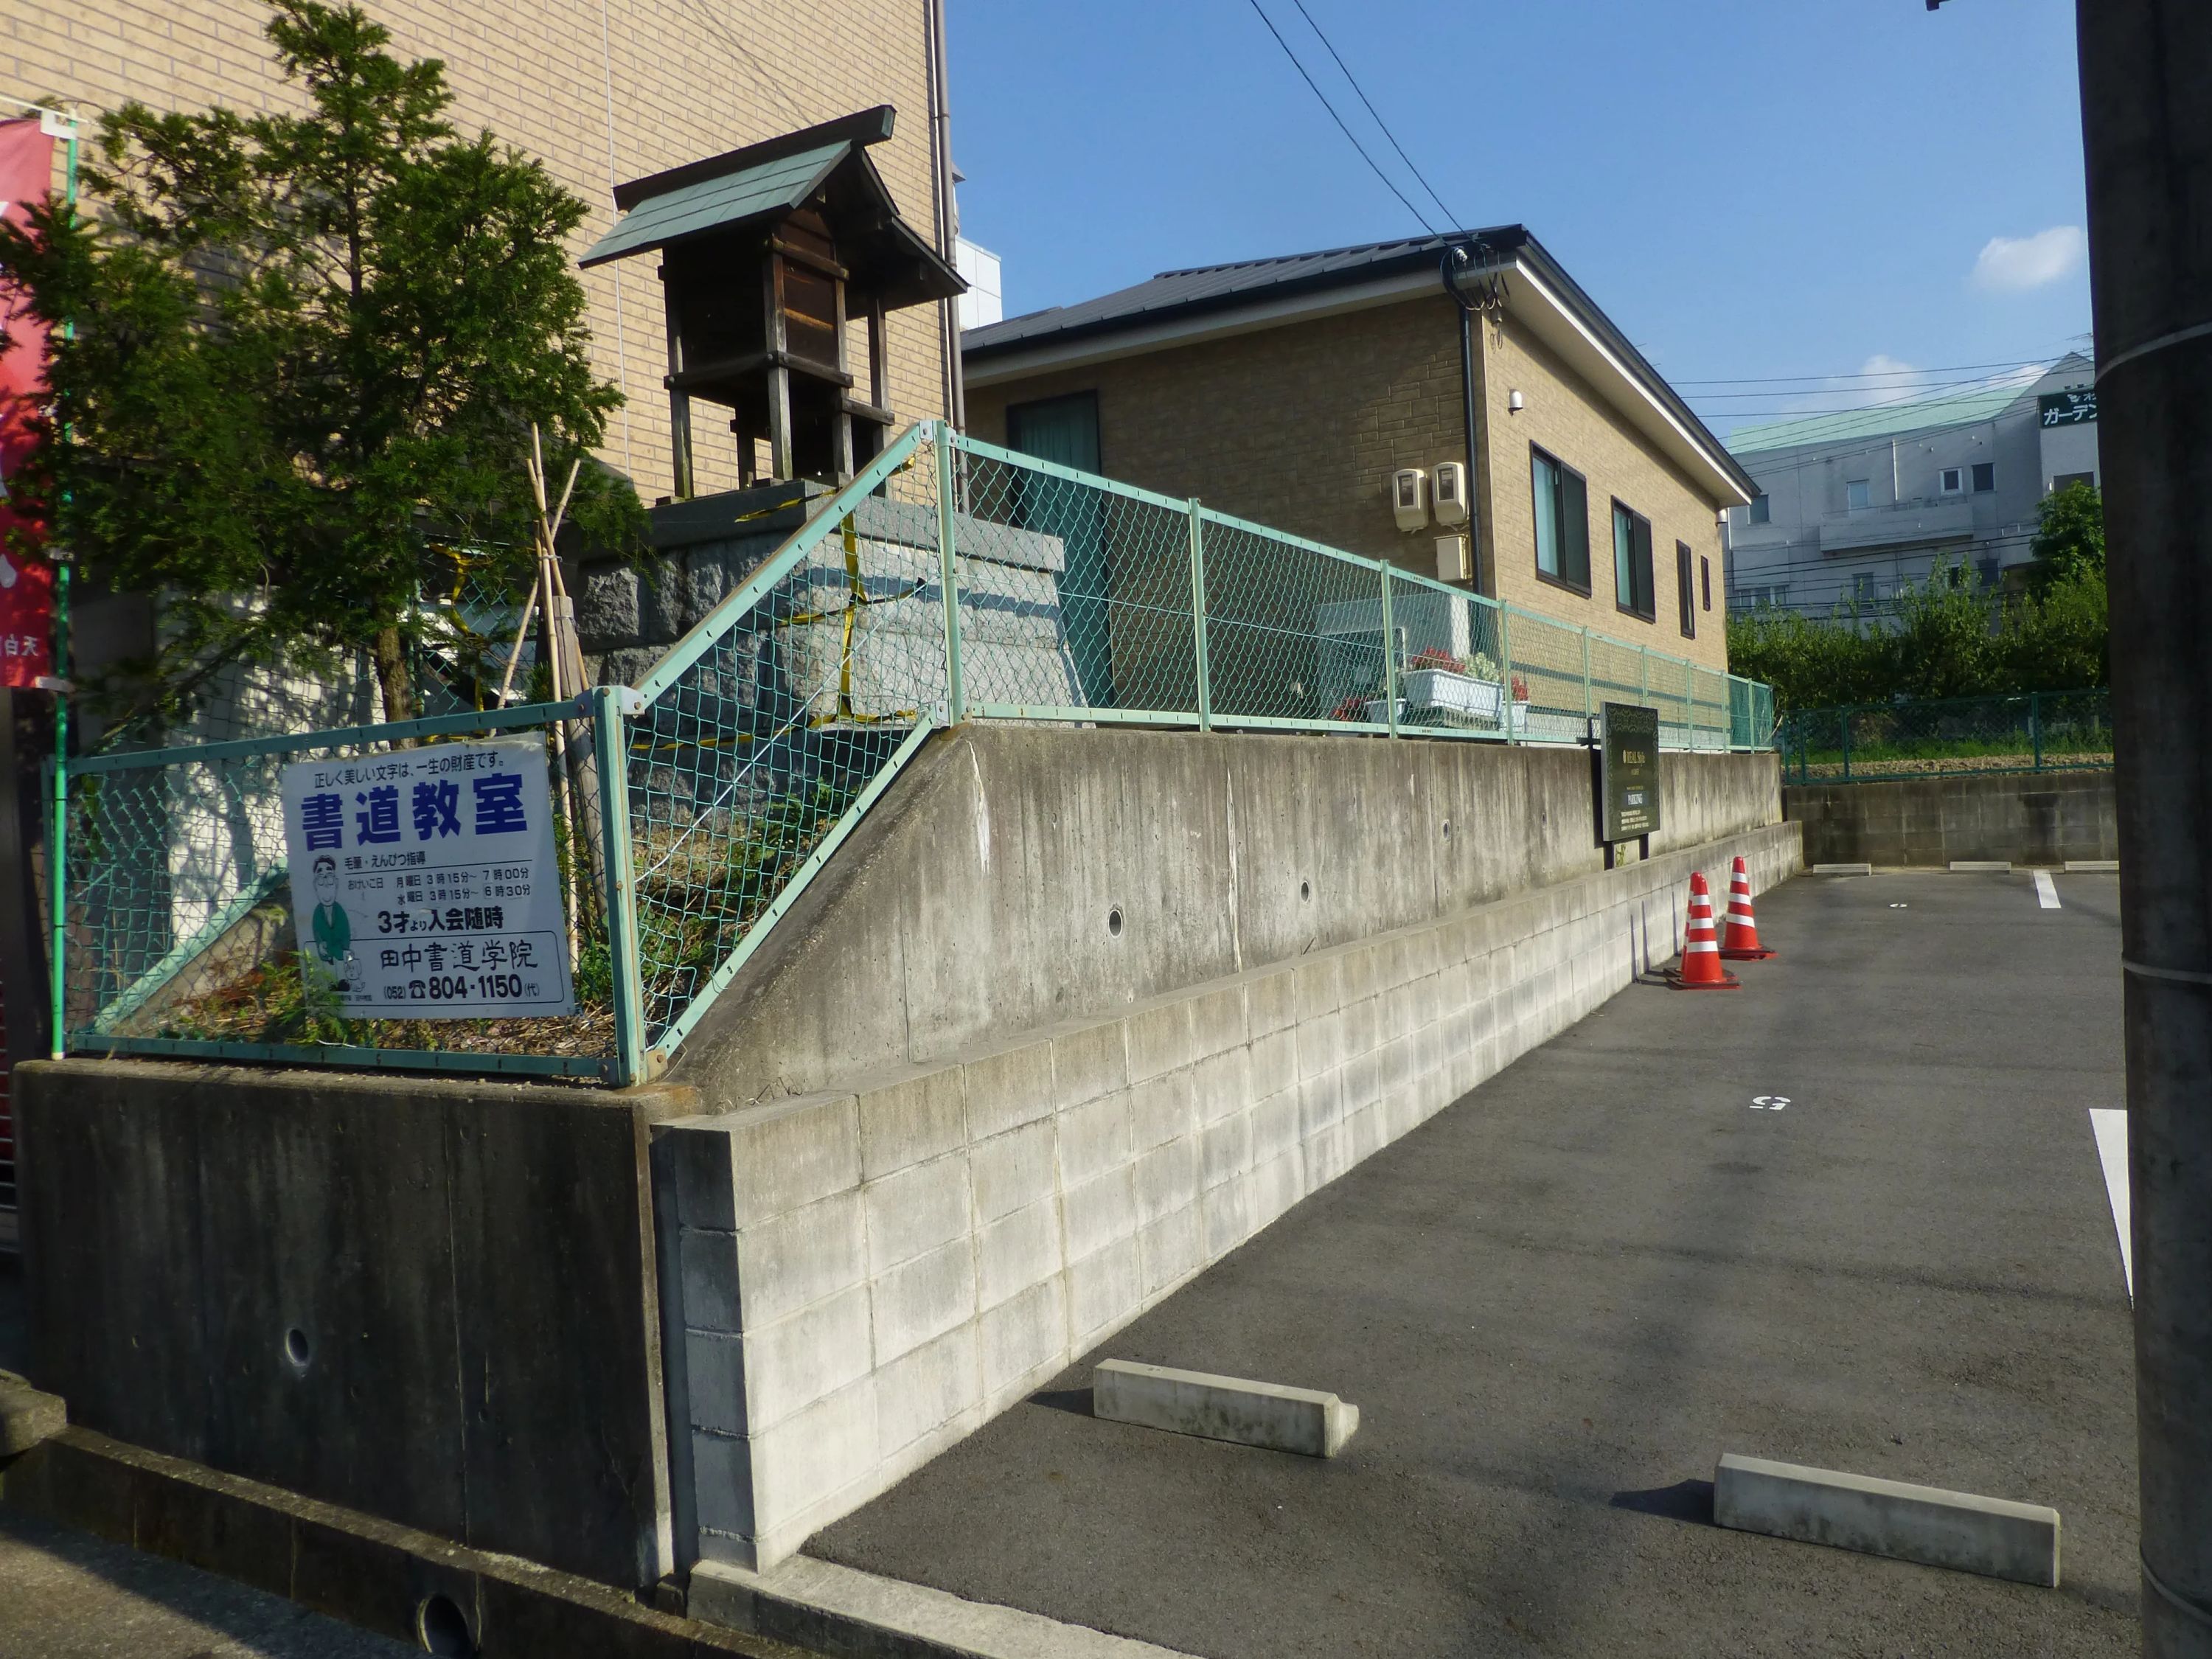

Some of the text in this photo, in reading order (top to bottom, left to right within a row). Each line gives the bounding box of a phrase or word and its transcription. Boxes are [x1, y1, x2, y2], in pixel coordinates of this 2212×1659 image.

[315, 751, 504, 789] 正しく美しい文字は、一生の財産です。
[301, 772, 528, 852] 書道教室
[380, 939, 538, 973] 田中書道学院
[383, 984, 406, 1000] (052)
